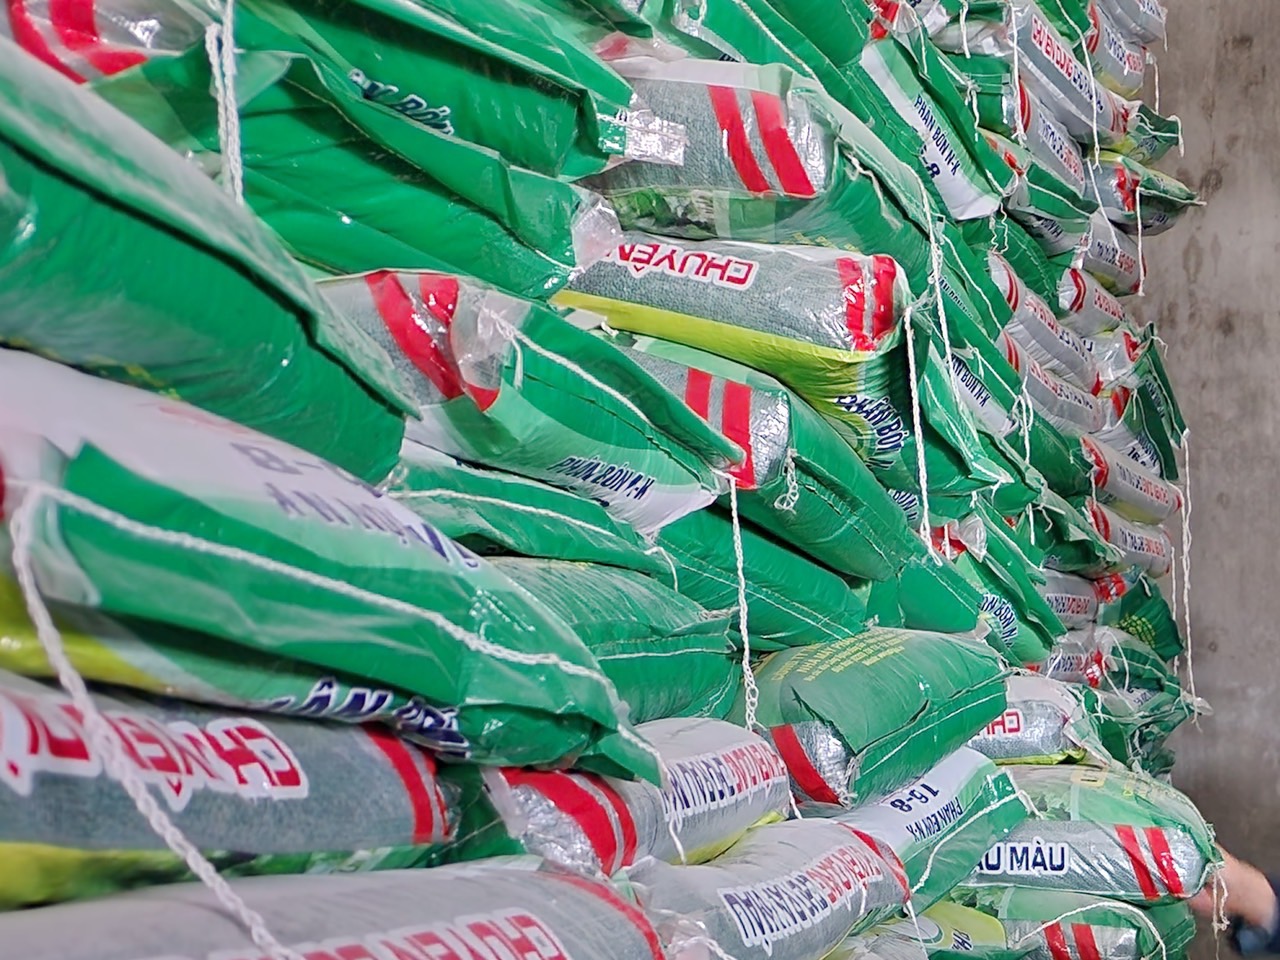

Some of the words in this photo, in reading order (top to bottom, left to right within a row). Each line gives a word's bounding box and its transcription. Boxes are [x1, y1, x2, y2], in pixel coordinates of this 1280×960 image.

[914, 95, 935, 130] PHÂN
[618, 243, 753, 286] CHUYÊN
[891, 783, 939, 813] 16-8
[1010, 842, 1065, 871] MÀU
